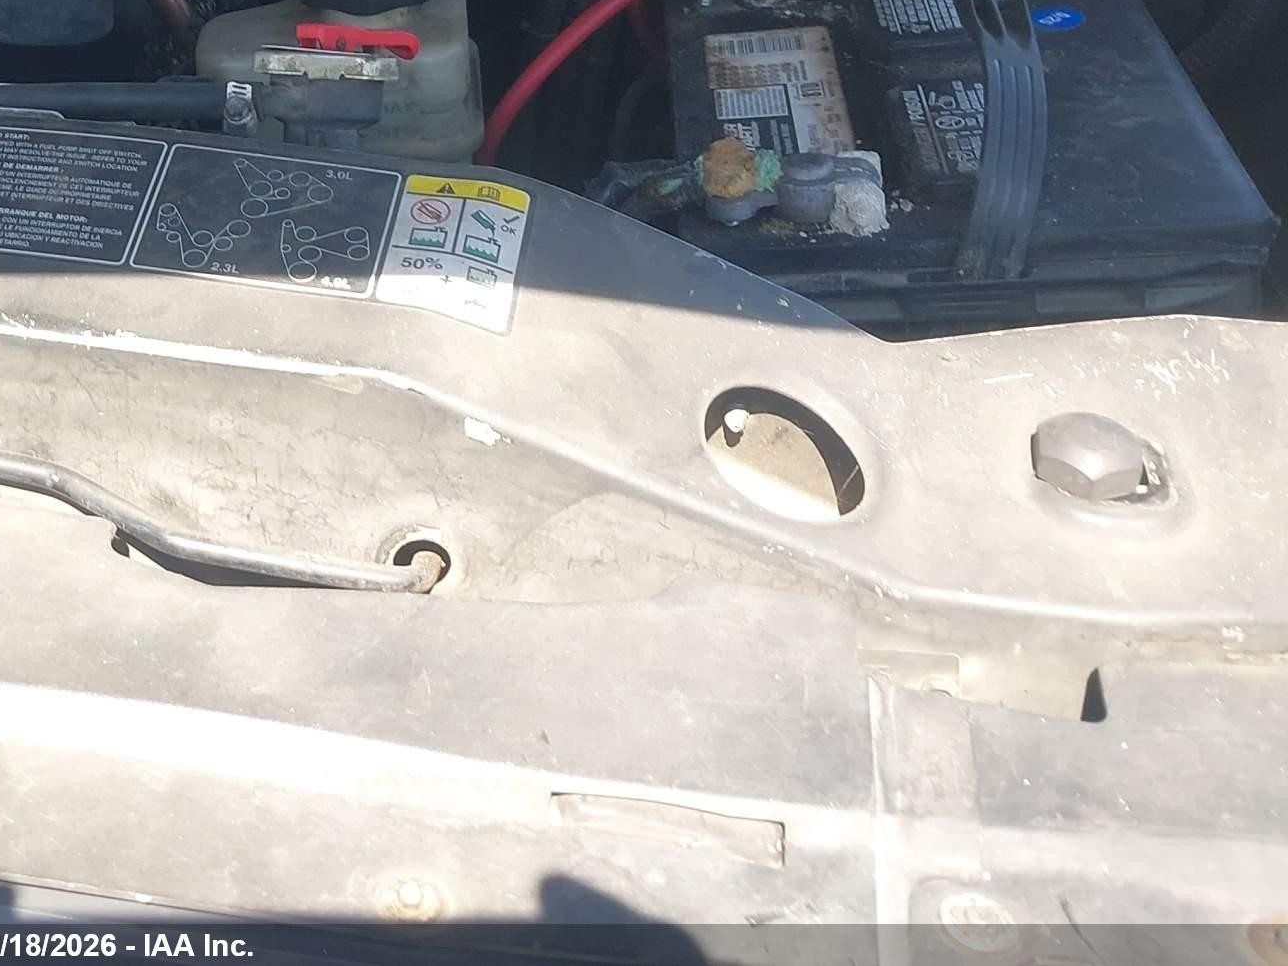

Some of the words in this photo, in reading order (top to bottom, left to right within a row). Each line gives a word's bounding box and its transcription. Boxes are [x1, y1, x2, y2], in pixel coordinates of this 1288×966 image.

[325, 169, 353, 182] 3.0L
[36, 211, 55, 219] DEL
[499, 223, 518, 234] OK
[211, 262, 240, 275] 2.3L
[400, 255, 444, 272] 50%
